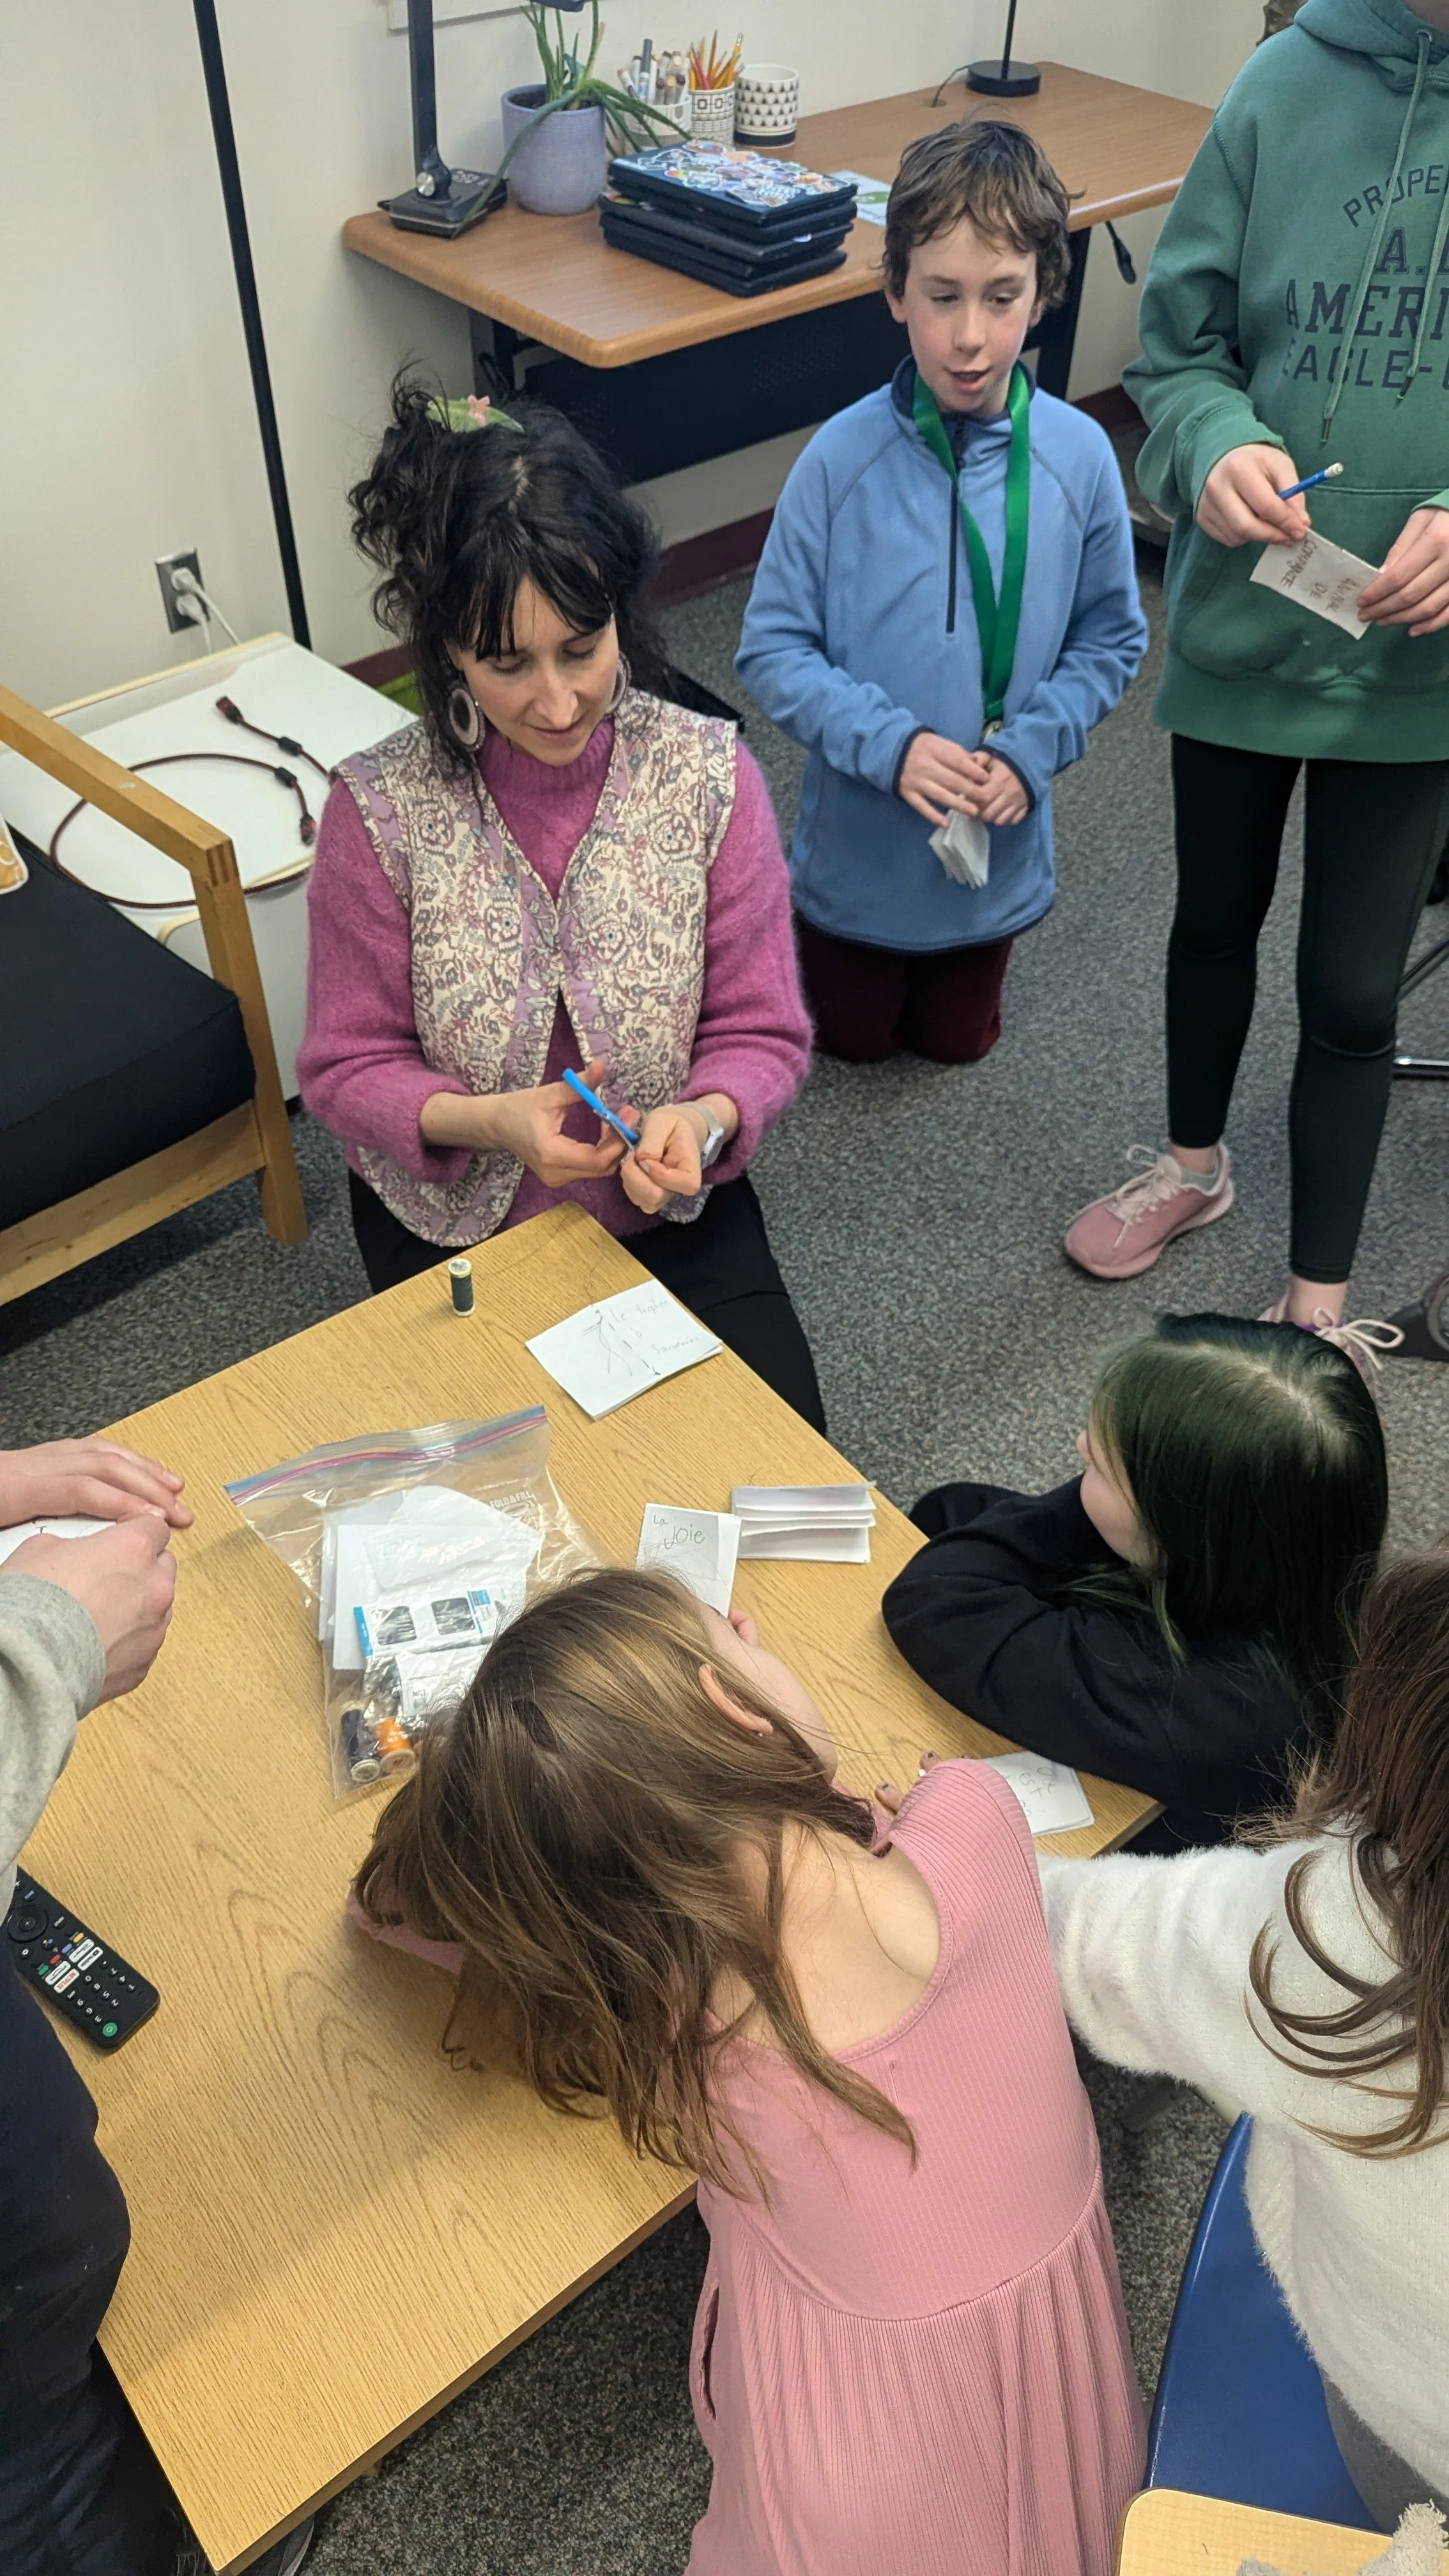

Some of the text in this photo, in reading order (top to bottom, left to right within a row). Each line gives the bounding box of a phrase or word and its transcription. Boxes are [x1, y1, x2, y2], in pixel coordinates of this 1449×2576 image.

[1342, 164, 1449, 227] PROPE
[653, 1515, 669, 1526] La
[57, 1972, 77, 1990] NETFLIX
